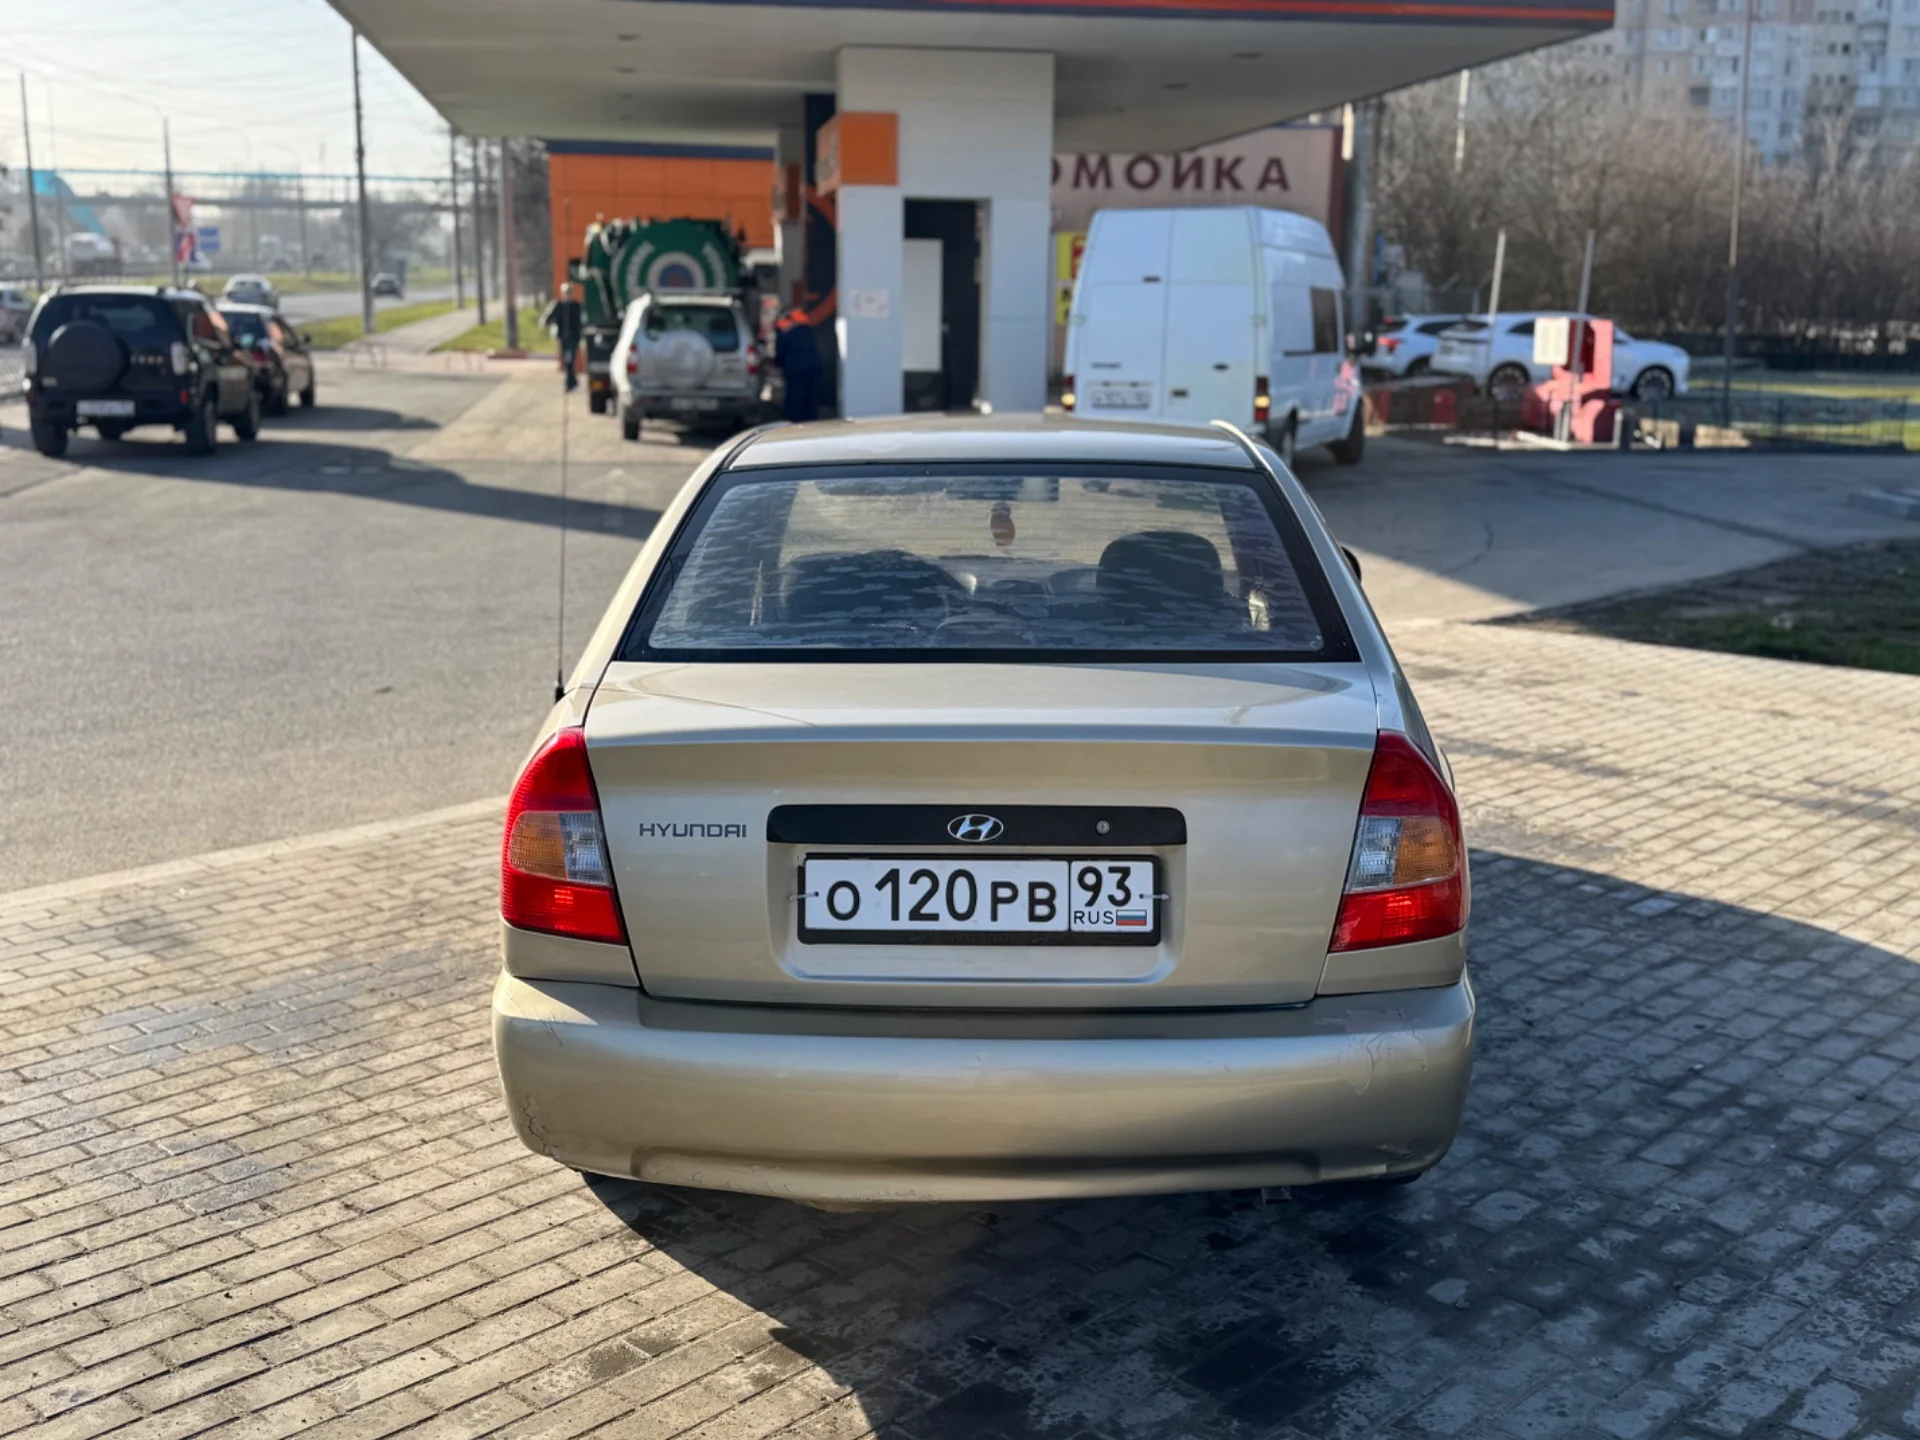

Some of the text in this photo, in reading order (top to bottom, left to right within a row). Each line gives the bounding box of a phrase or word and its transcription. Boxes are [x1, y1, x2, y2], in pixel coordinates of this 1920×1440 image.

[639, 822, 747, 839] HYUNDAI
[1076, 865, 1132, 908] 93
[1073, 910, 1115, 926] RUS
